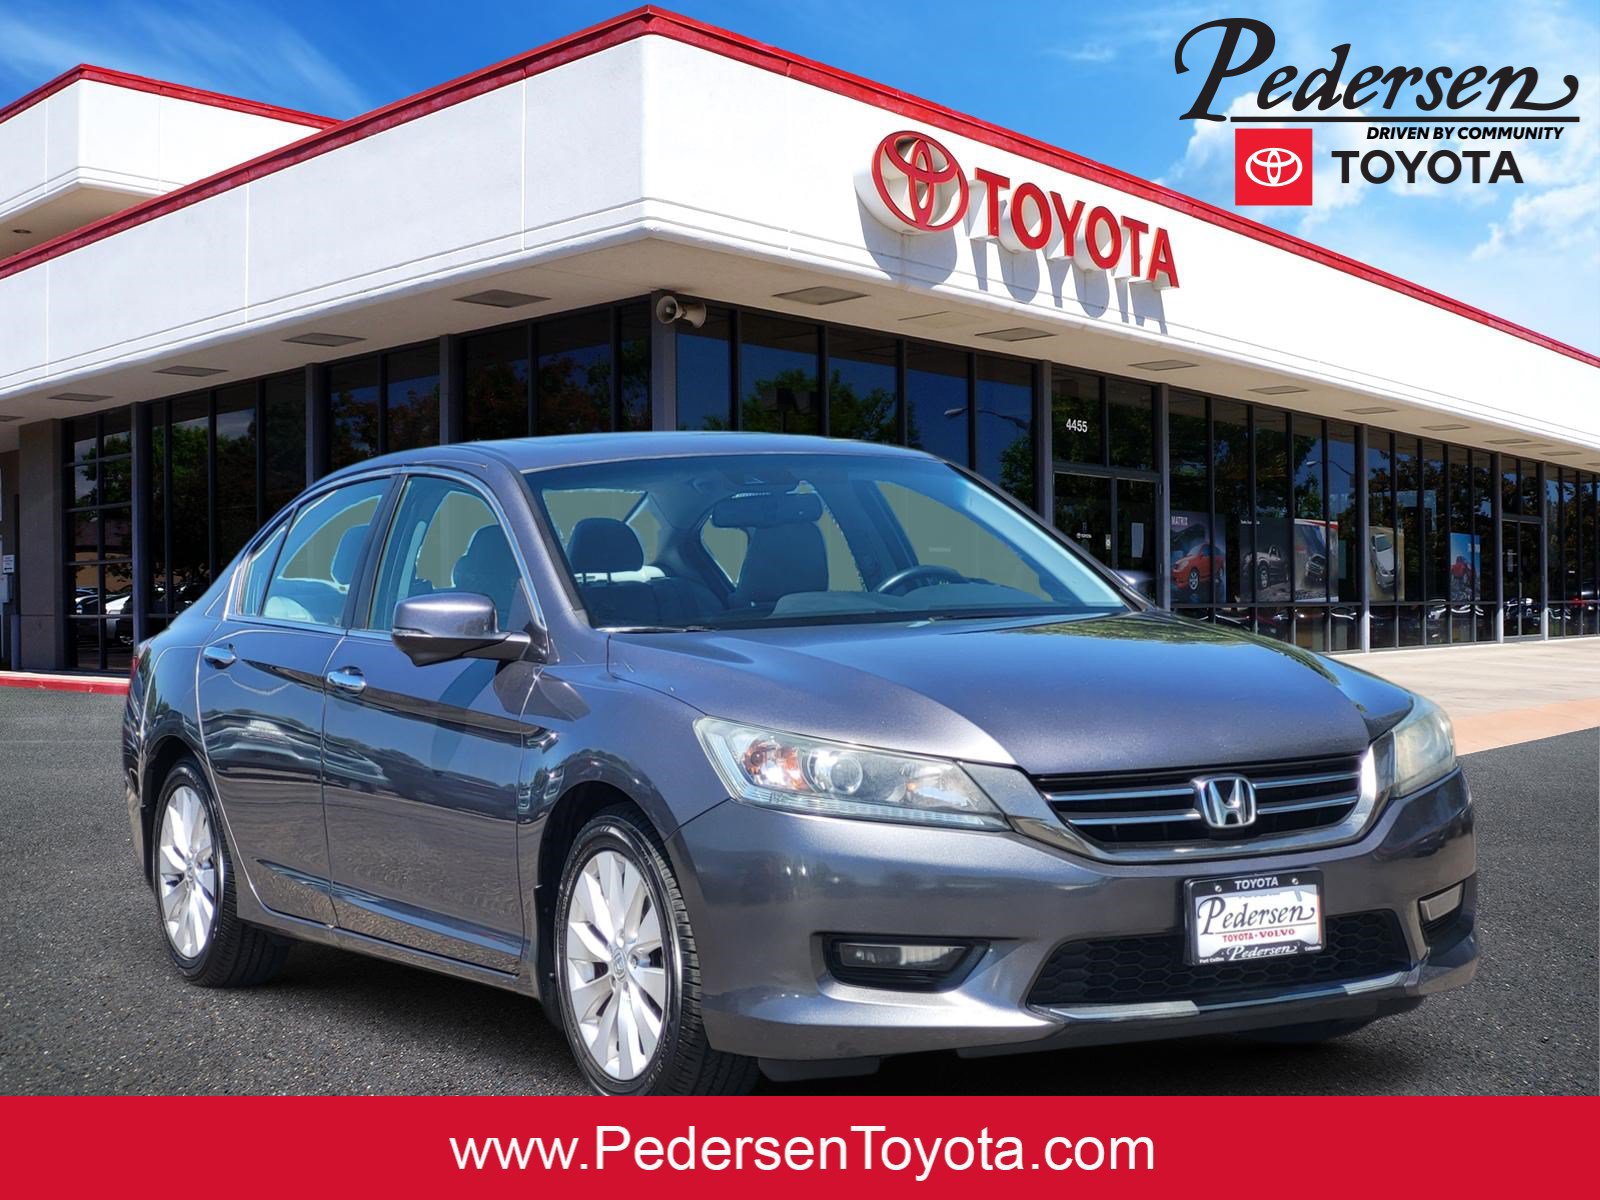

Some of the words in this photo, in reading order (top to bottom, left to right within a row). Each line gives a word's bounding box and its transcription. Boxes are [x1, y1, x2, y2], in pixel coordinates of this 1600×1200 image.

[974, 167, 1180, 289] TOYOTA
[1065, 418, 1088, 433] 4455
[1234, 876, 1279, 890] TOYOTA
[1197, 896, 1315, 936] Pedersen
[1222, 932, 1254, 943] TOYOTA
[1259, 928, 1296, 938] VOLVO
[1226, 944, 1298, 961] Pedersen
